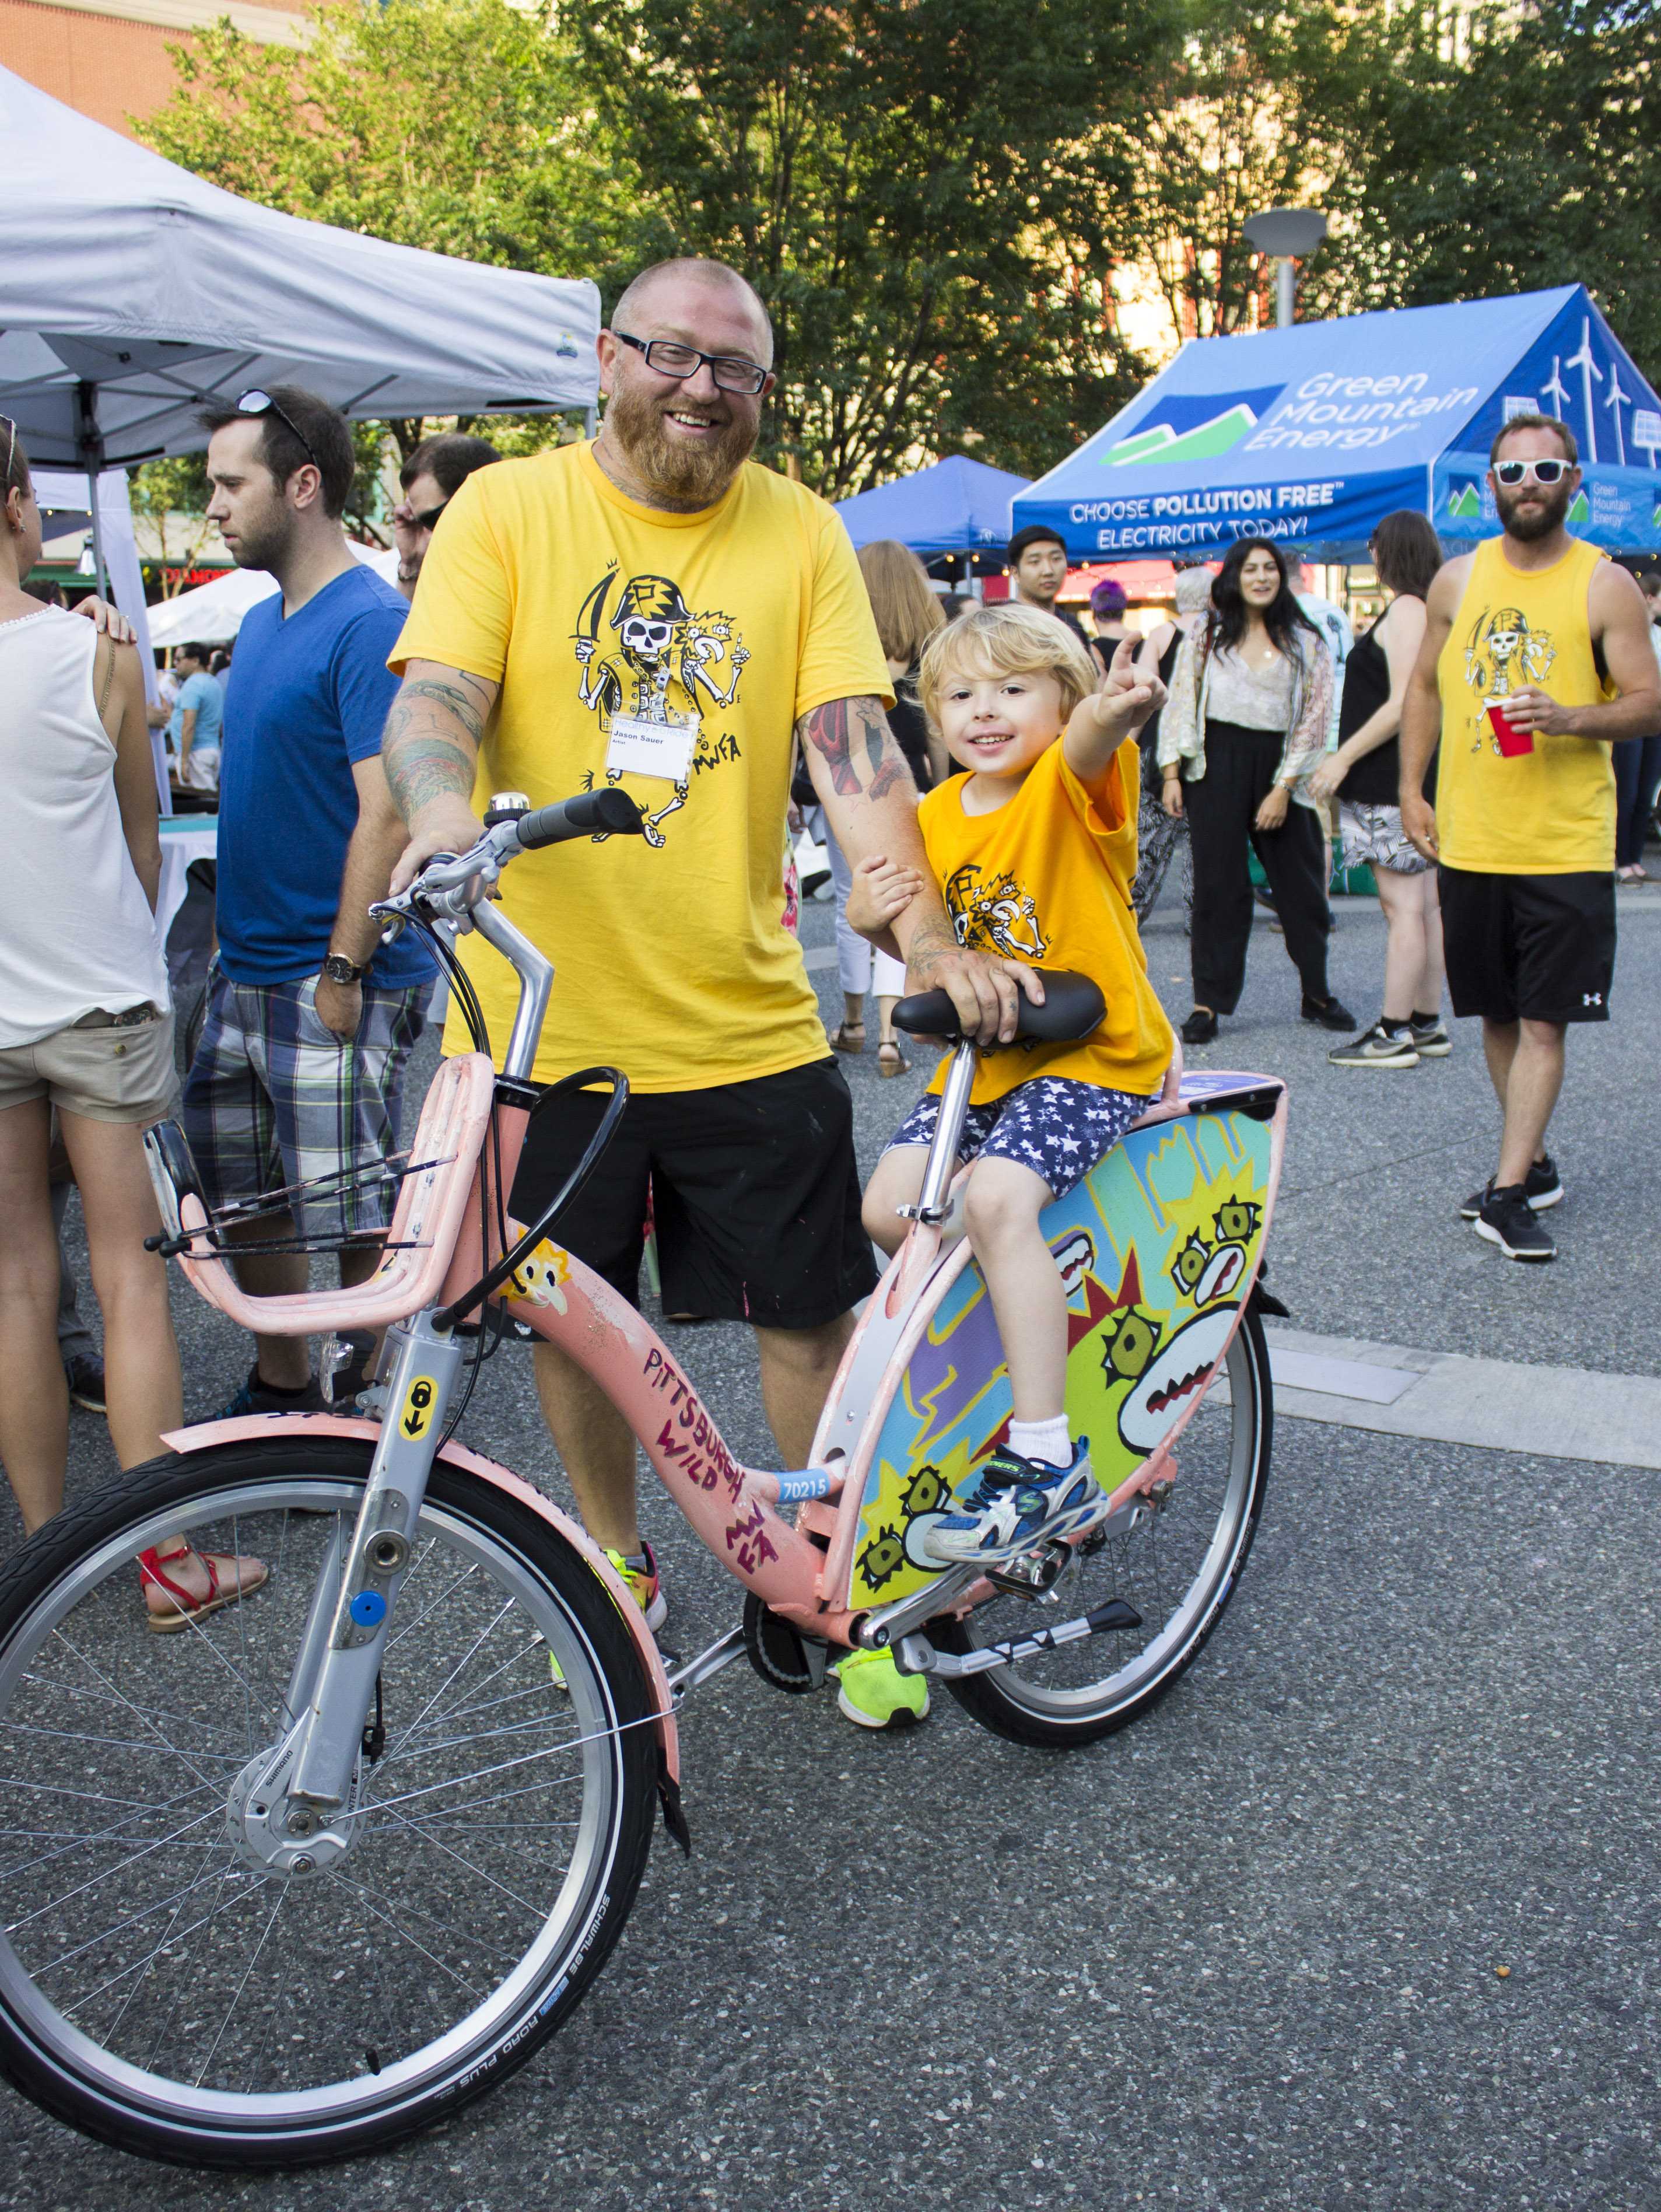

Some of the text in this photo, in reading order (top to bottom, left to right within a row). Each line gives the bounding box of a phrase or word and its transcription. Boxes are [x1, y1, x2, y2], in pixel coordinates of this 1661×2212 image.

[1296, 372, 1429, 400] Green
[1270, 387, 1479, 427] Mountain
[1069, 499, 1151, 523] CHOOSE
[1152, 488, 1273, 518] POLLUTION
[1593, 482, 1618, 496] Green
[1593, 499, 1632, 512] Mountain
[1096, 516, 1309, 550] ELECTRICITY TODAY!
[614, 730, 664, 745] Jason Sauer
[692, 733, 742, 775] MWFA
[643, 1348, 747, 1504] PITTSBURGH
[655, 1419, 718, 1491] WILD
[784, 1478, 827, 1499] 70215
[265, 1750, 293, 1787] SHIMANO
[568, 1893, 611, 1976] SCHWALBE
[459, 2015, 539, 2088] ROAD PLUS
